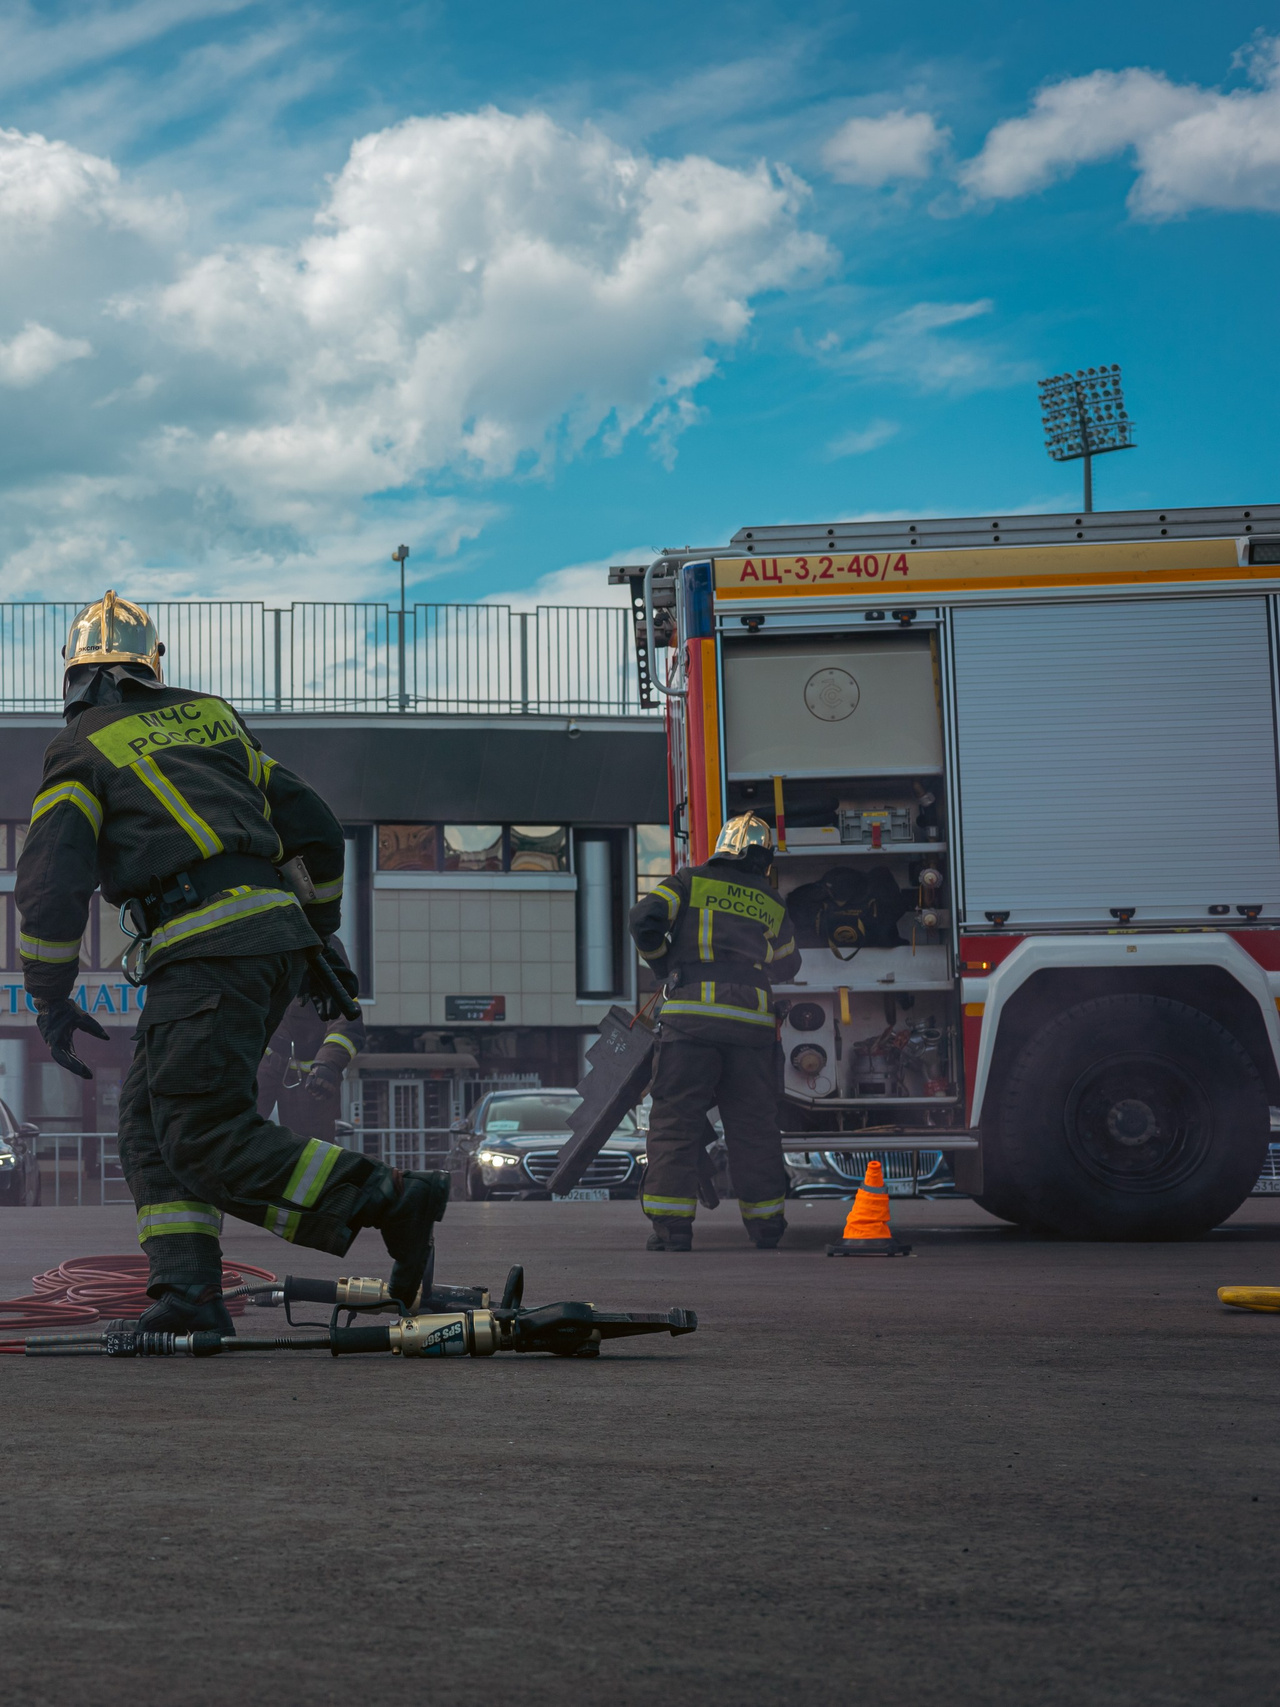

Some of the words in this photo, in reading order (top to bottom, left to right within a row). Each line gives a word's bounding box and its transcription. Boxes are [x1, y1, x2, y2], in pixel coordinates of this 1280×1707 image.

[739, 553, 909, 584] АЦ-3,2-40/4
[137, 703, 202, 728] МЧС
[727, 884, 765, 905] МЧС
[705, 895, 775, 929] РОССИИ
[442, 1323, 462, 1339] SPS
